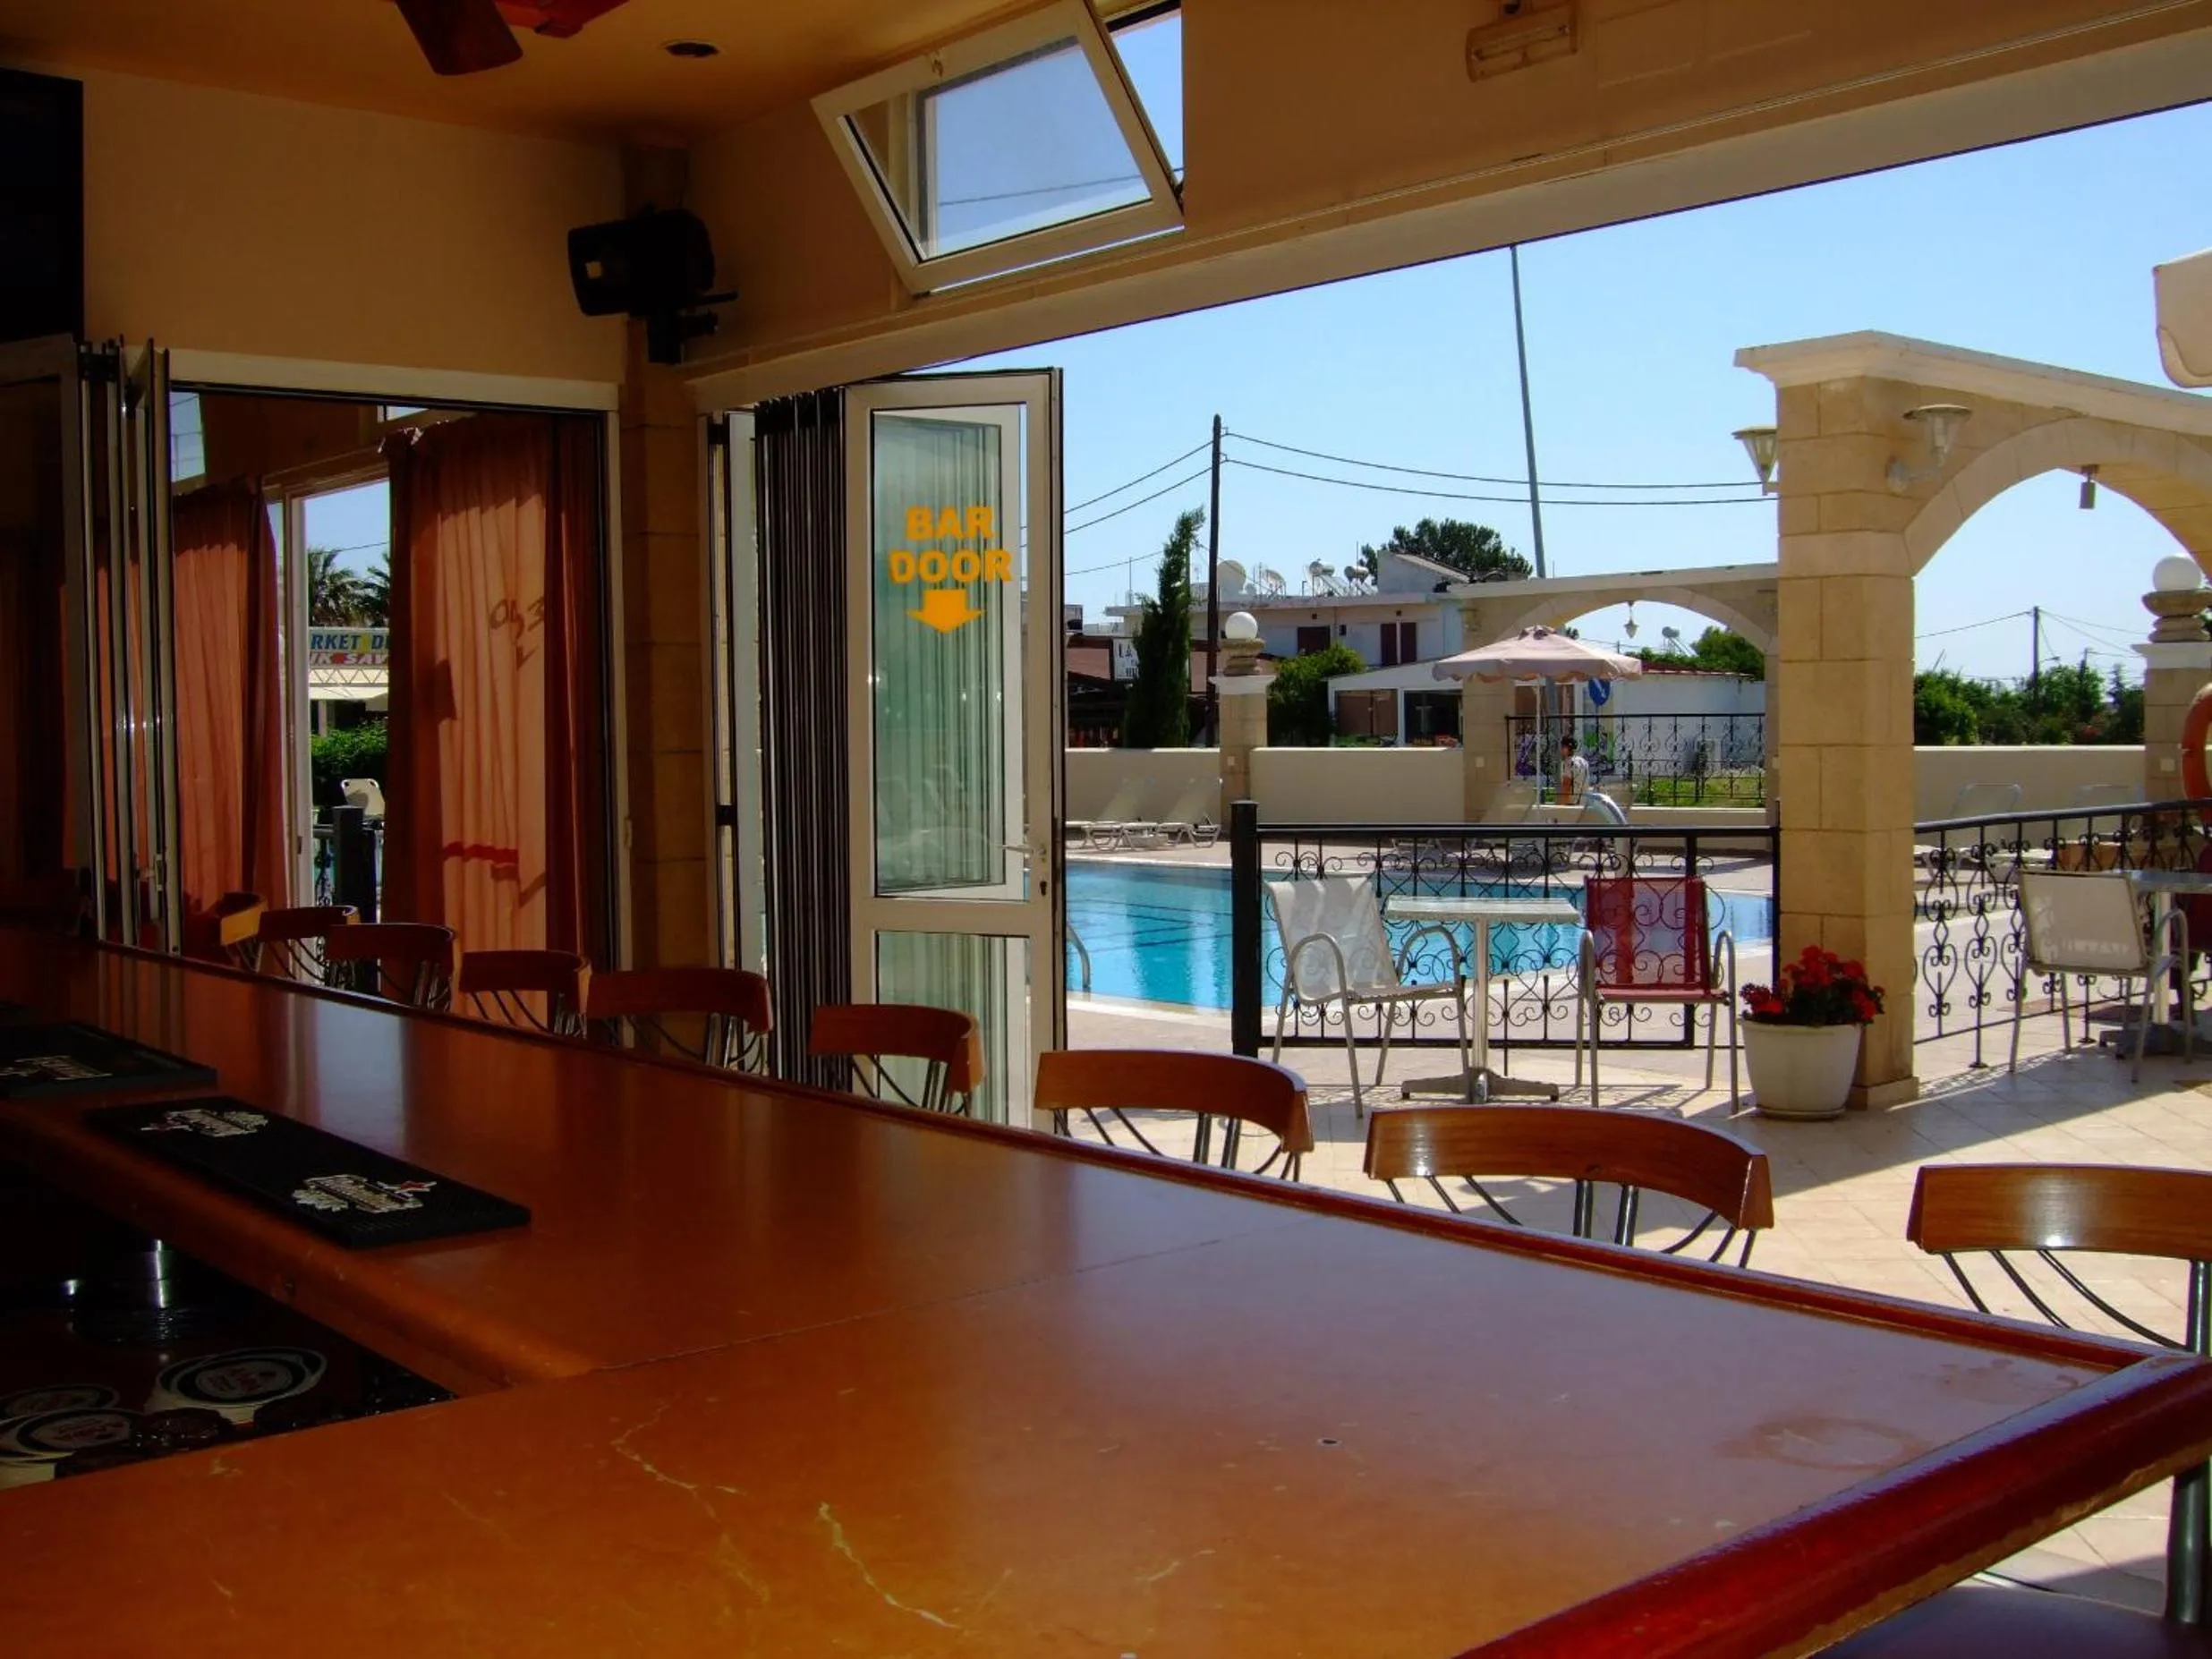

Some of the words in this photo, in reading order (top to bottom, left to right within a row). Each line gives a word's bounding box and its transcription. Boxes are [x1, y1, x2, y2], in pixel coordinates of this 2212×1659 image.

[906, 505, 995, 540] BAR
[889, 549, 1013, 583] DOOR
[311, 634, 362, 649] RKET
